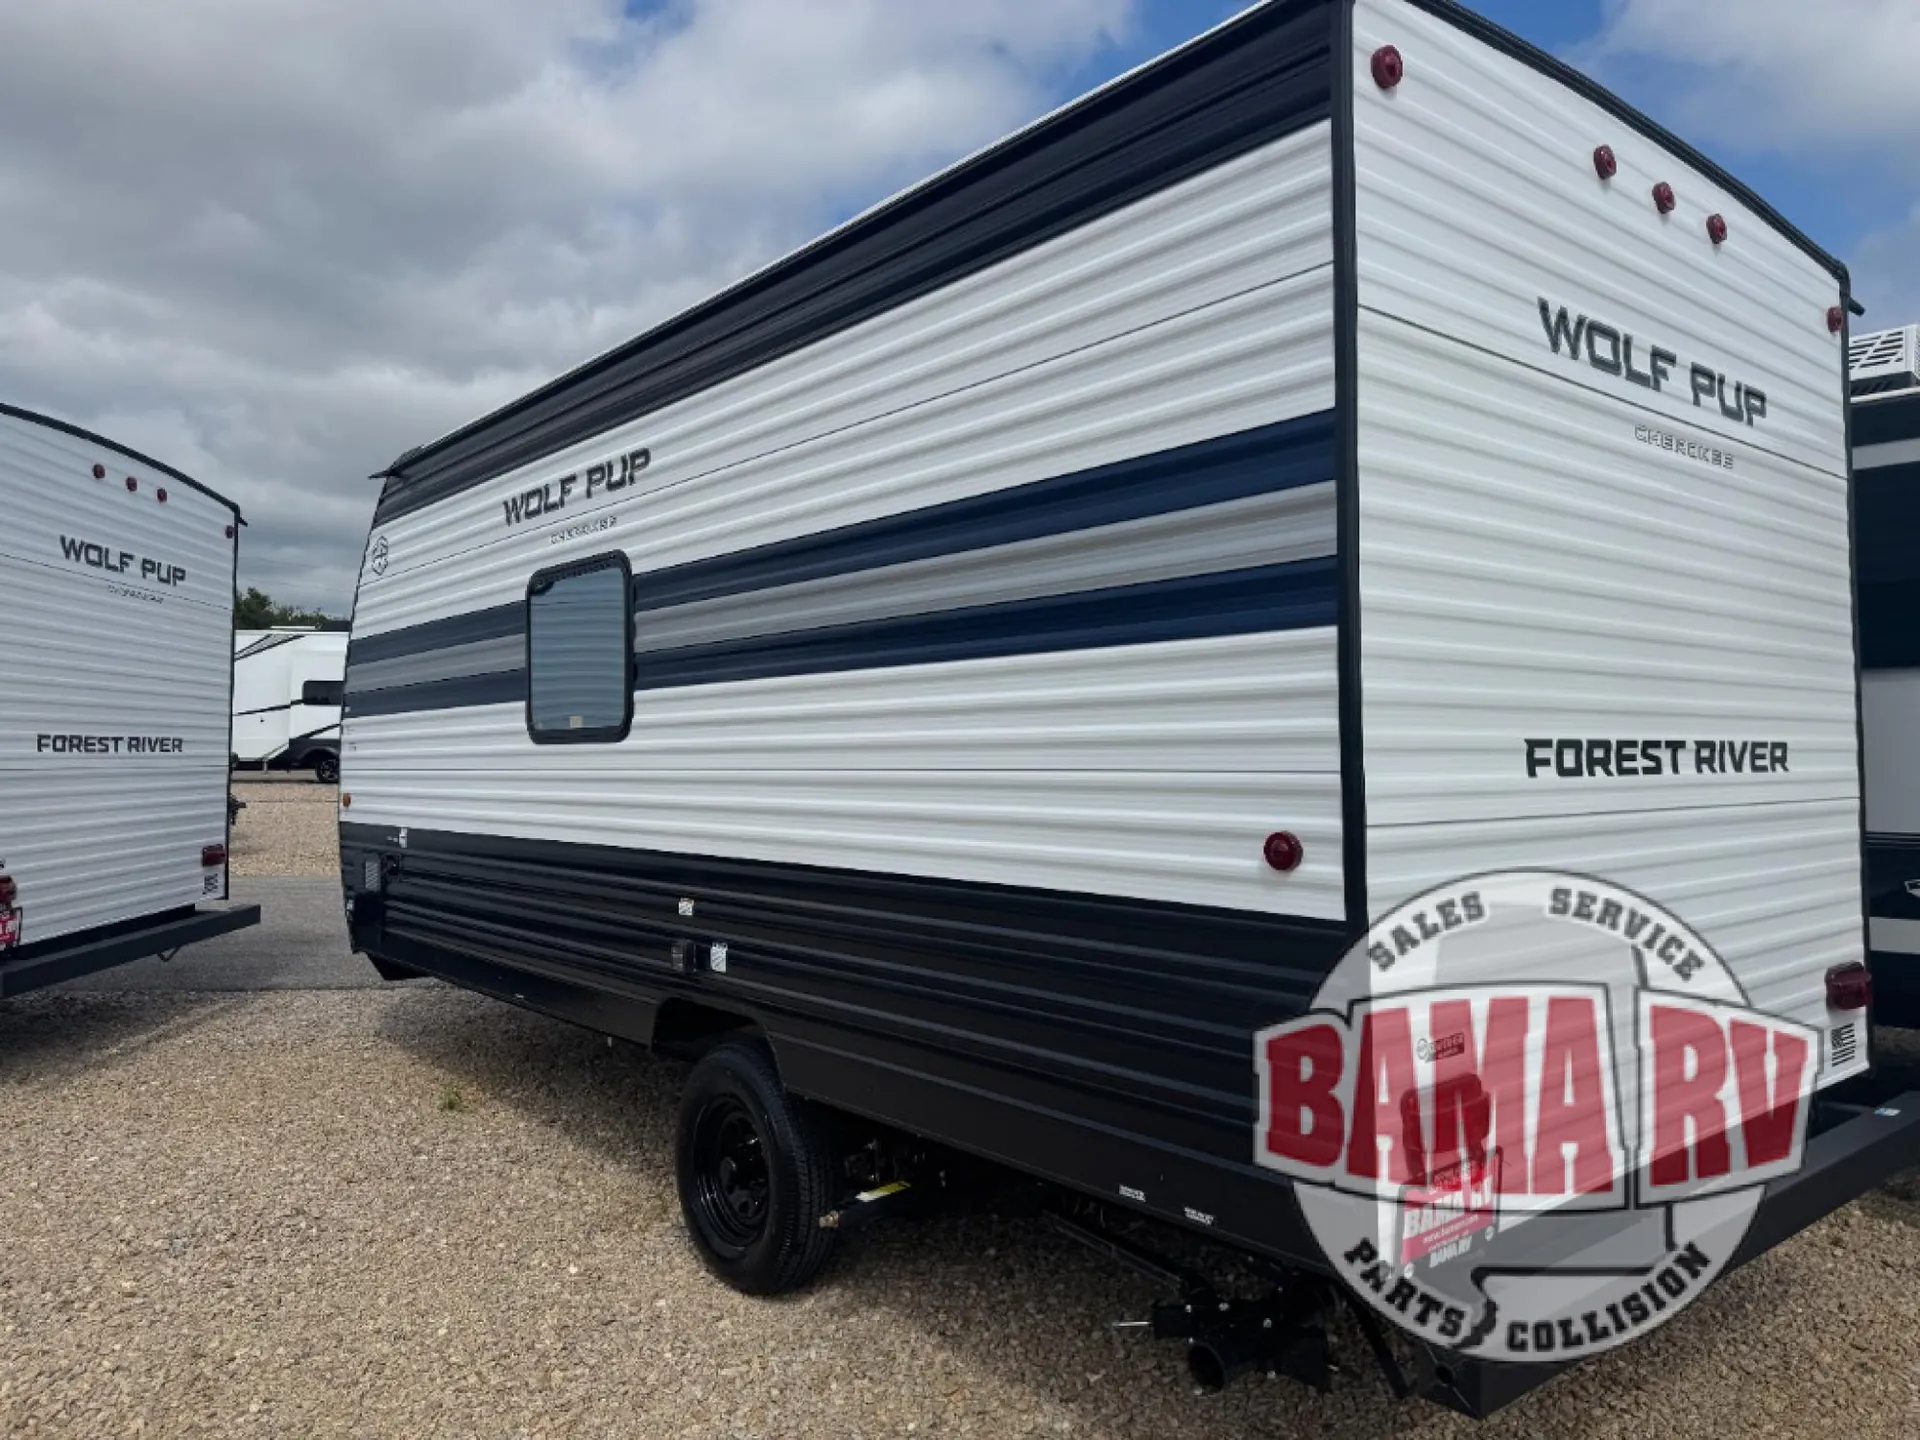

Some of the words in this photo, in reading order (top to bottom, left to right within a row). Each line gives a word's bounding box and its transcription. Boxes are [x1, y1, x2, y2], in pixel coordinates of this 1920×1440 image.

[1538, 297, 1676, 391] WOLF
[1690, 361, 1767, 427] PUP
[503, 472, 577, 526] WOLF
[586, 447, 650, 498] PUP
[60, 534, 135, 575] WOLF
[141, 557, 186, 587] PUP
[37, 734, 124, 753] FOREST
[127, 736, 183, 753] RIVER
[1524, 738, 1686, 778] FOREST
[1693, 740, 1790, 774] RIVER
